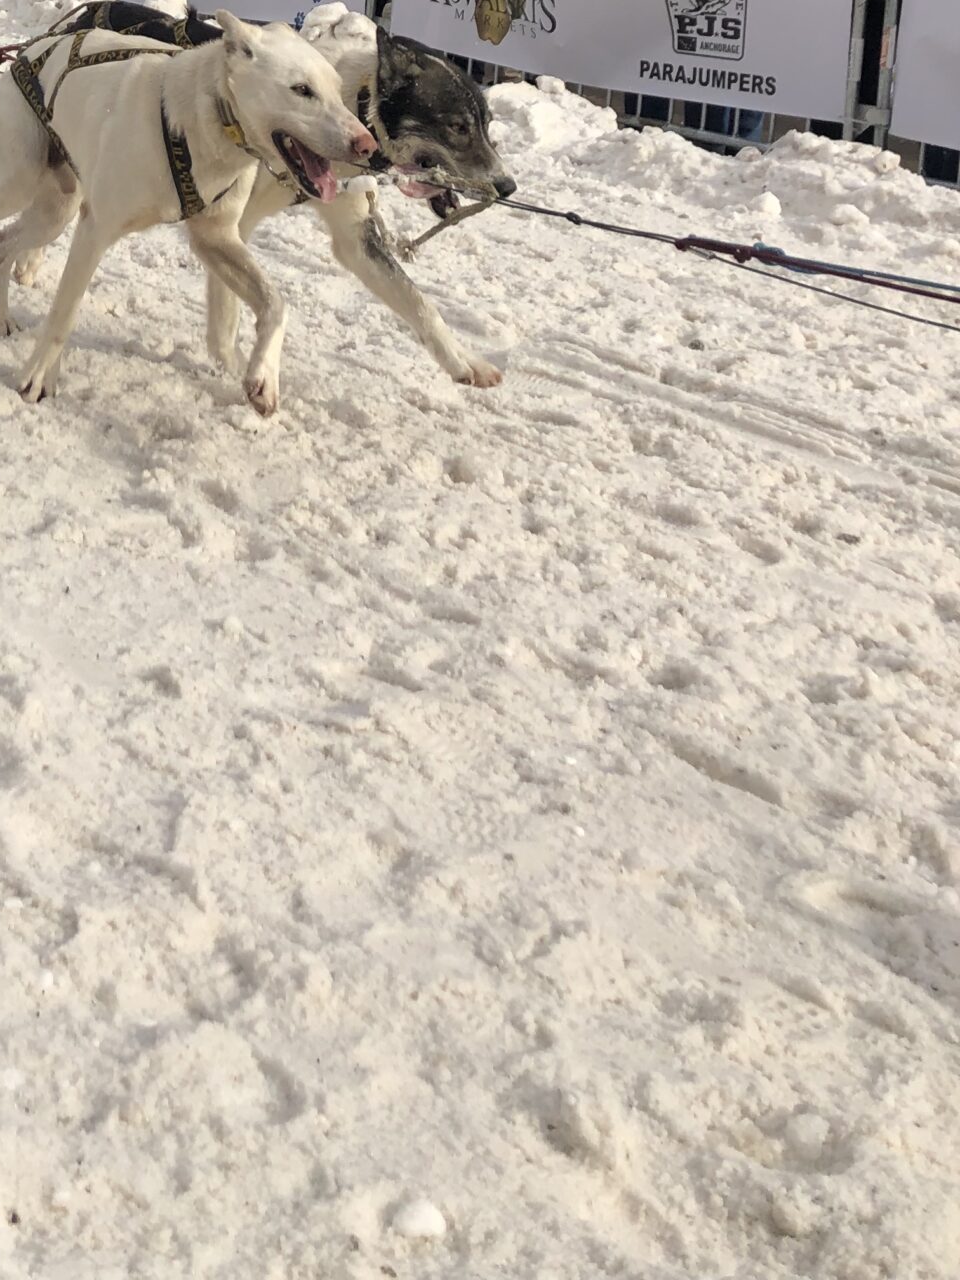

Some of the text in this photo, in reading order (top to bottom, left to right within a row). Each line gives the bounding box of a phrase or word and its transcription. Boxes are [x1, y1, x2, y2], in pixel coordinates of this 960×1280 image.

[454, 8, 537, 39] MARKETS
[699, 40, 740, 54] ANCHORAGE
[640, 59, 777, 96] PARAJUMPERS
